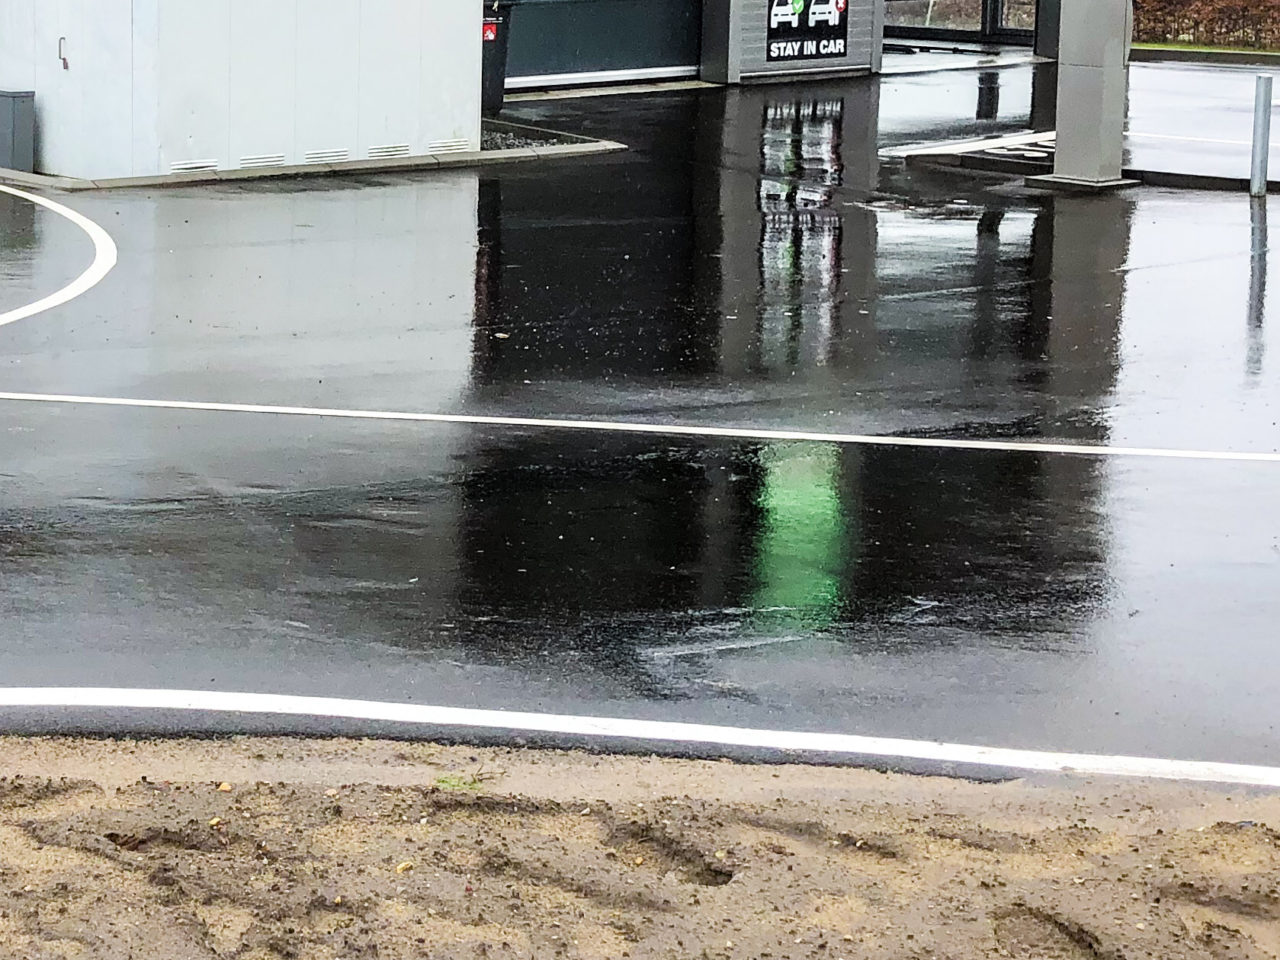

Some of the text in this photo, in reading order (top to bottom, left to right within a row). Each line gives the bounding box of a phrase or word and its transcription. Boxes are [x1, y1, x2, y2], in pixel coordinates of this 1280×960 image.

[770, 39, 845, 57] STAY IN CAR
